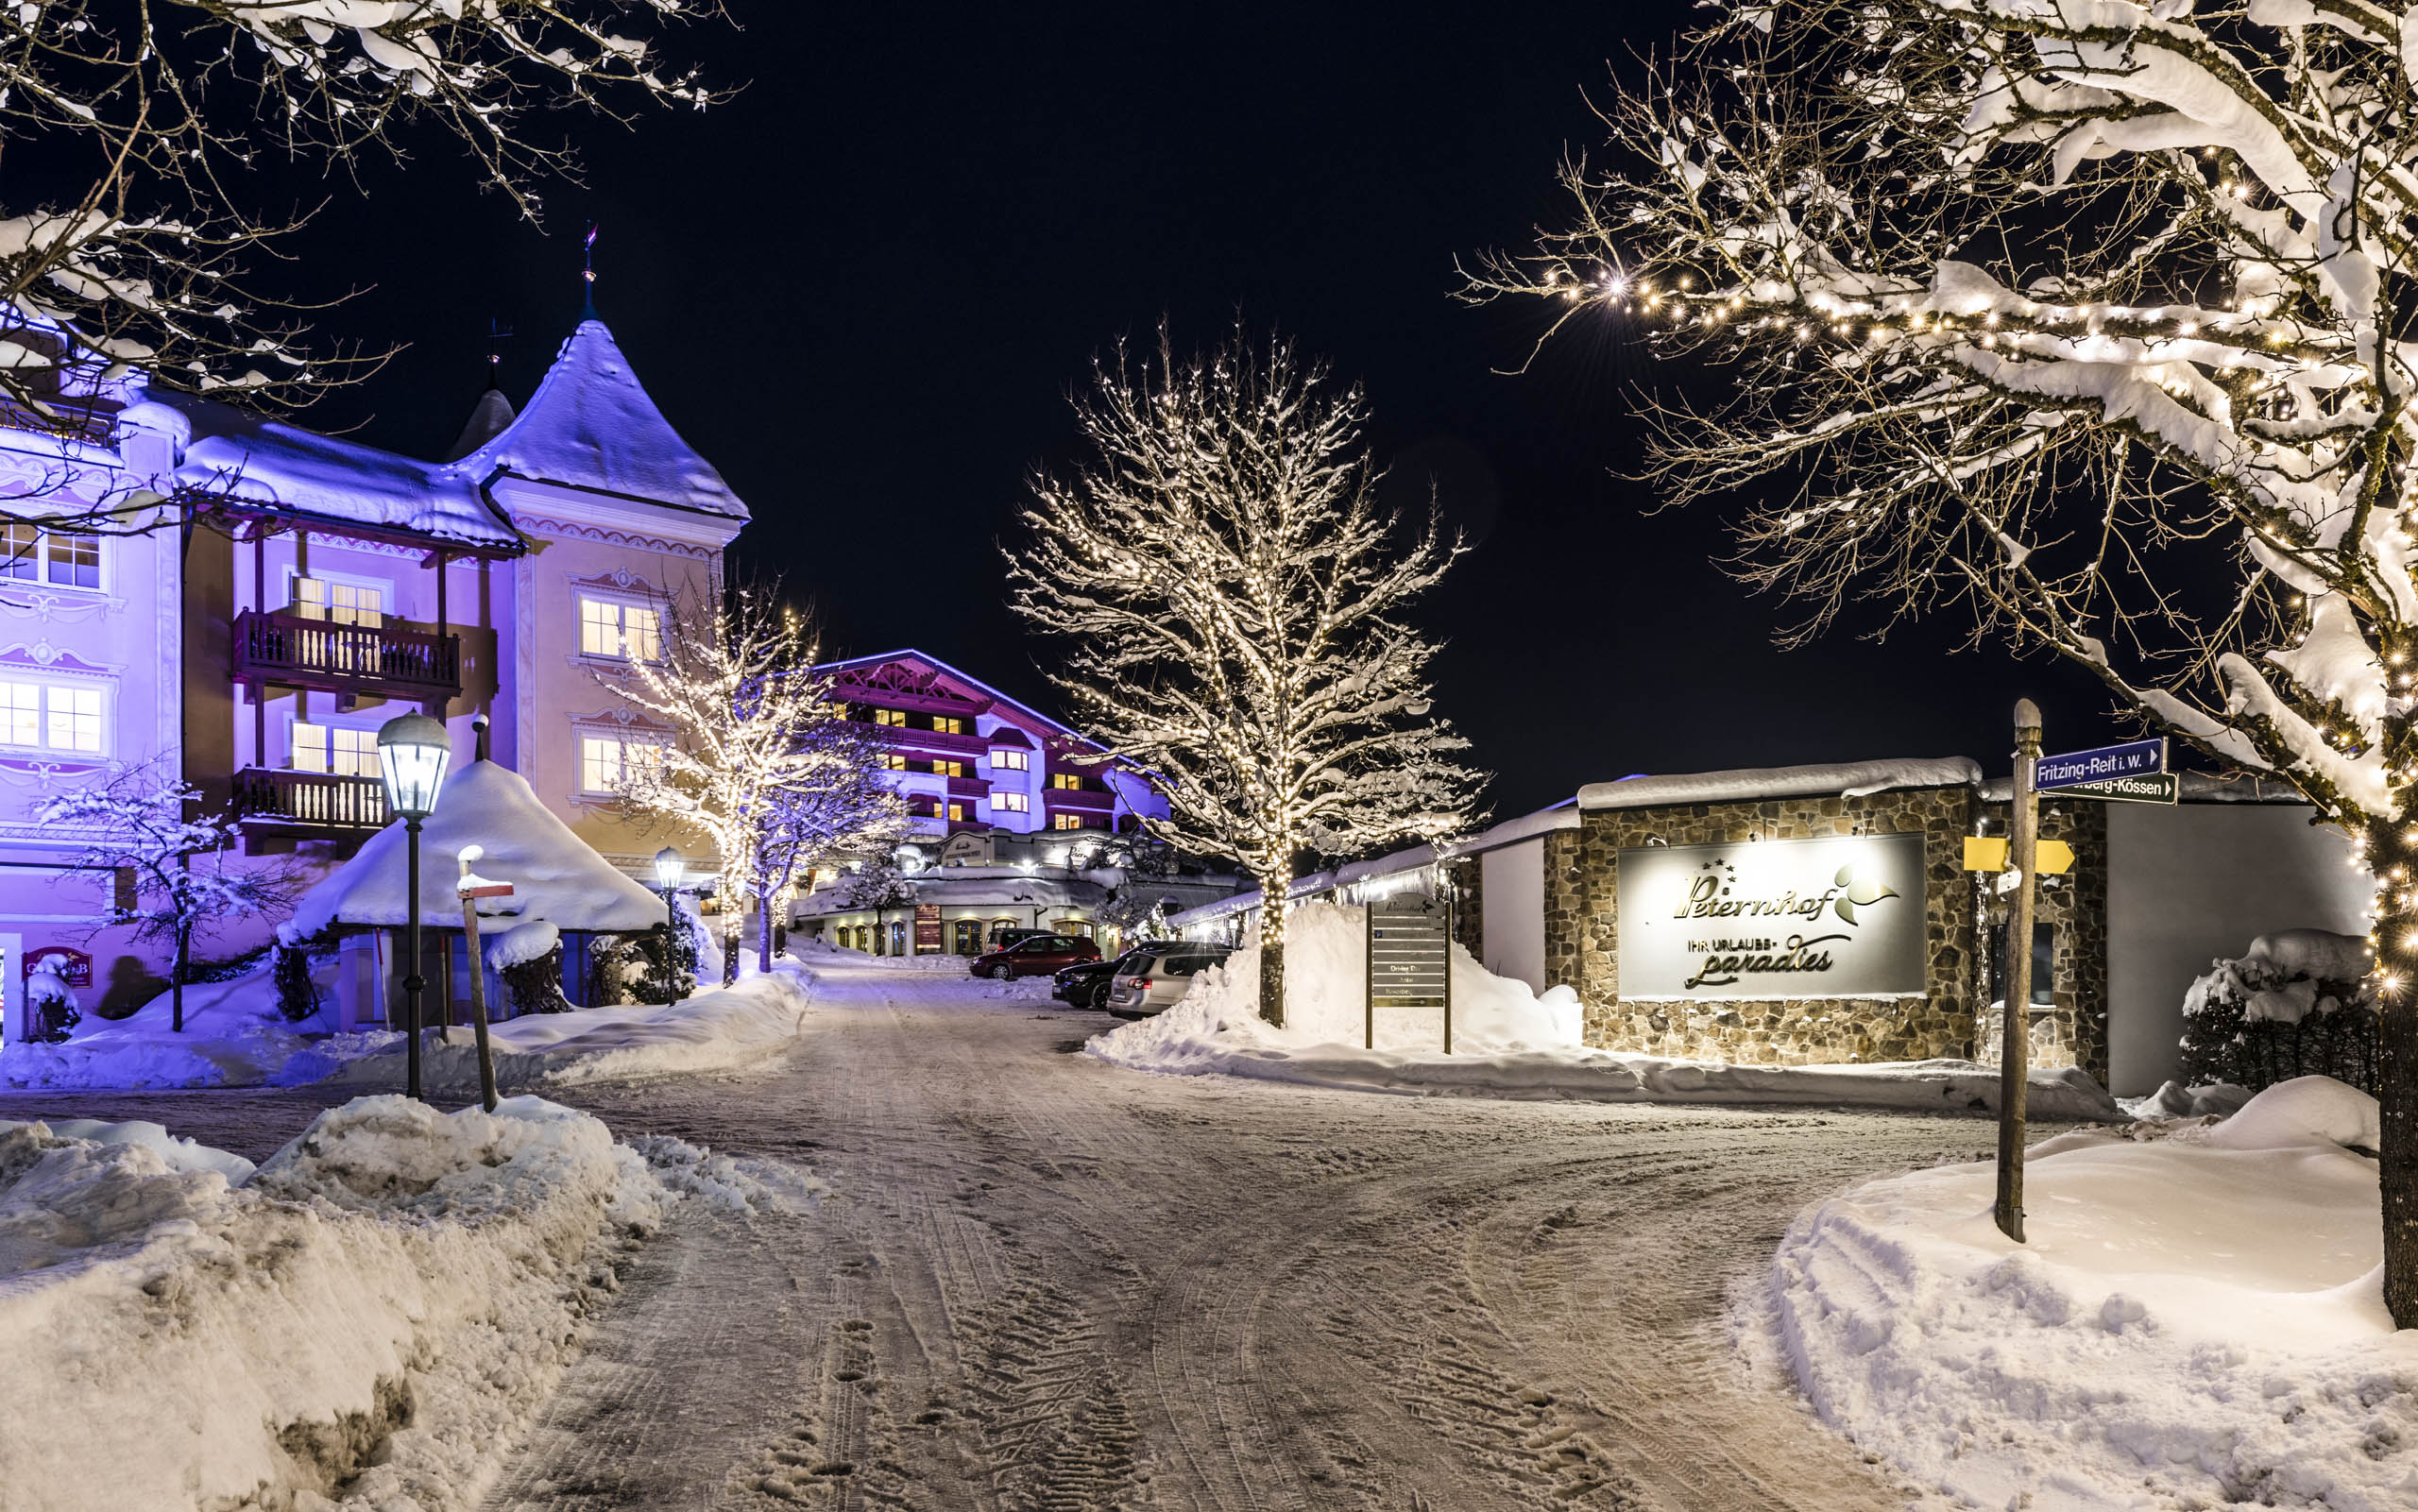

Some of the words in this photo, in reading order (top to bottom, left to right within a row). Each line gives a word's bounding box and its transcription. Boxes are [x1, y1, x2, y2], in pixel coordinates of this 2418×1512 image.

[2038, 756, 2117, 782] Fritzing-Reit
[2127, 754, 2142, 768] W.
[1673, 875, 1838, 922] Peternhof
[1684, 934, 1851, 990] paradies
[1688, 940, 1709, 953] IHR
[1712, 938, 1778, 952] URLAUBS-
